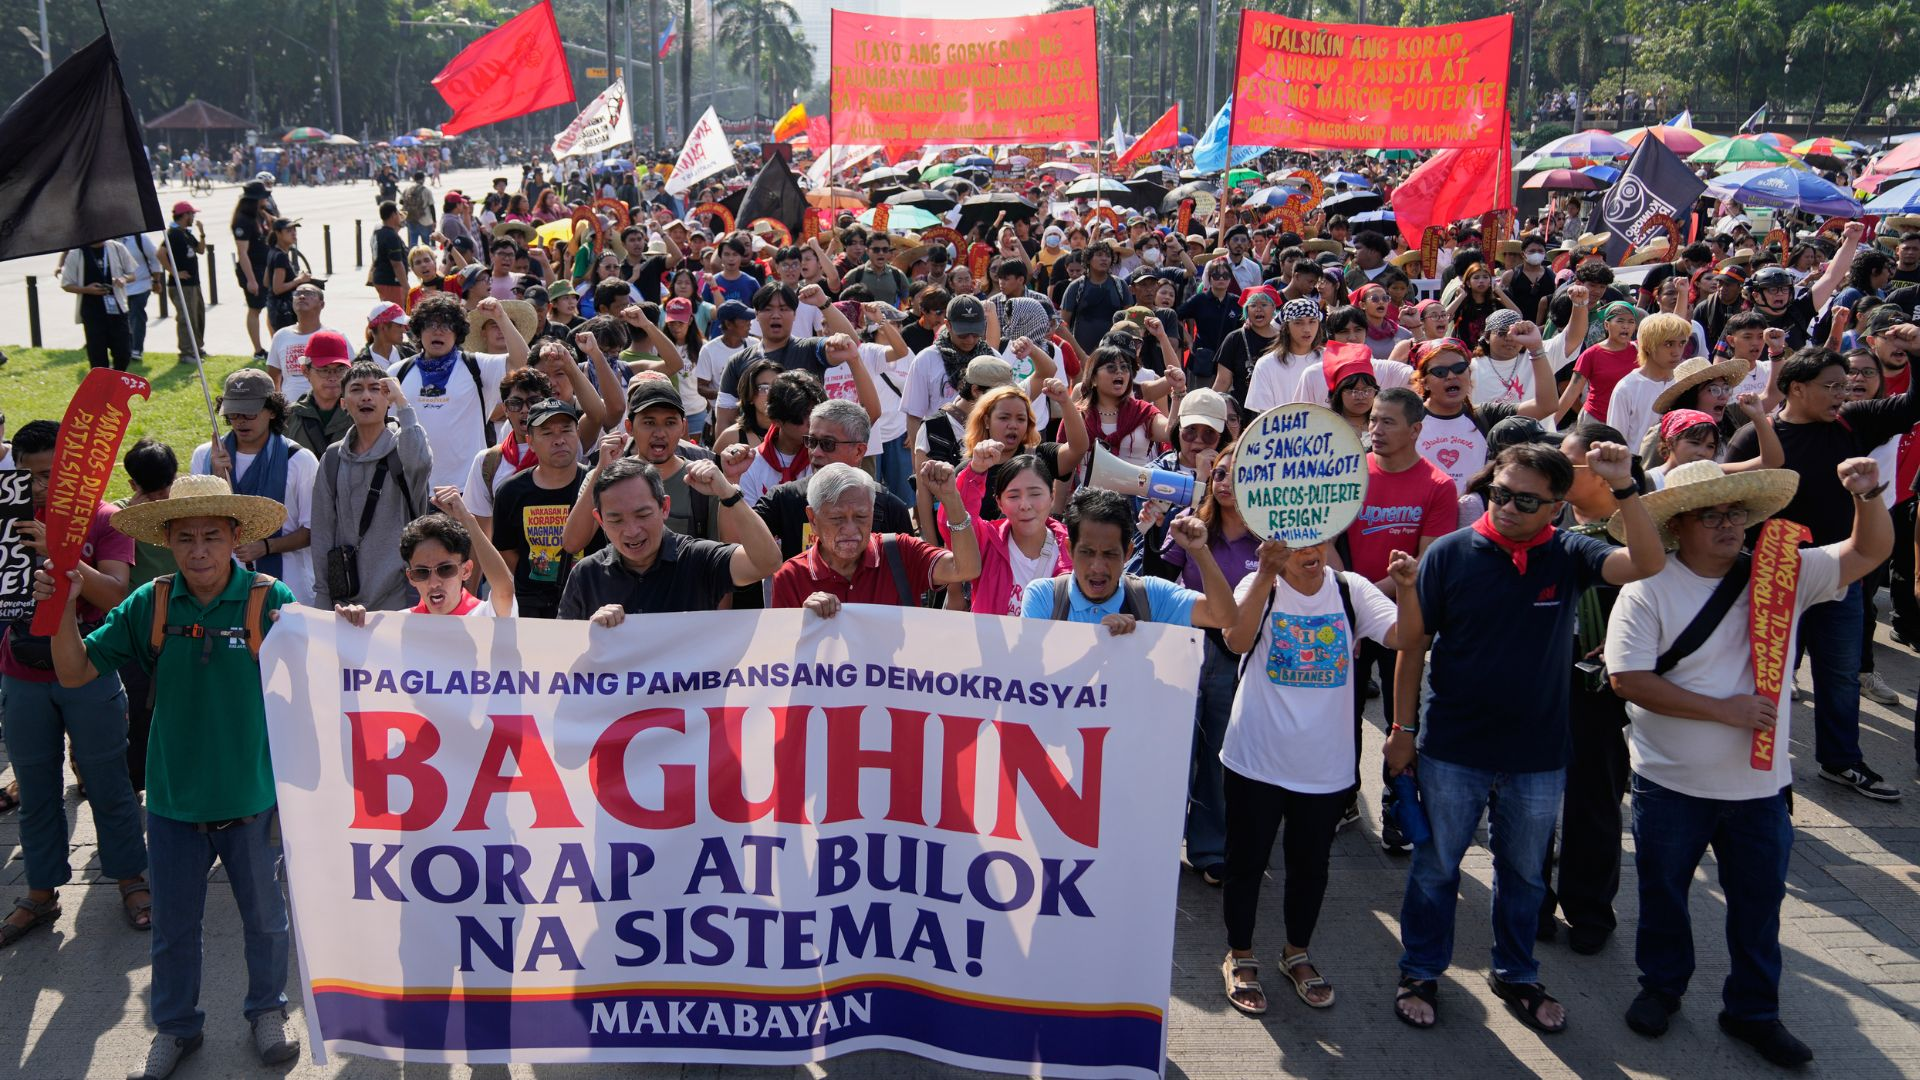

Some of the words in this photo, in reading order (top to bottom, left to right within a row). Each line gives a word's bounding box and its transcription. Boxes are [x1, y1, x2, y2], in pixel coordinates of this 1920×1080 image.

[854, 39, 901, 63] ITAYO
[908, 42, 941, 64] ANG
[946, 38, 1033, 65] GOBYERNO
[1039, 34, 1063, 56] NG
[1251, 20, 1345, 57] PATALSIKIN
[1349, 33, 1390, 60] ANG
[944, 64, 1032, 89] MAKIBAKA
[1038, 58, 1085, 82] PARA
[1352, 59, 1434, 85] PASISTA
[1440, 56, 1472, 83] AT
[831, 91, 851, 113] SA
[859, 91, 970, 113] PAMBANSANG
[1238, 76, 1311, 107] PESTENG
[1316, 80, 1504, 112] MARCOS-DUTERTE!
[992, 120, 1009, 136] NG
[1307, 119, 1388, 142] MAGBUBUKID
[1390, 125, 1409, 142] NG
[1412, 123, 1479, 143] PILIPINAS
[1262, 411, 1310, 436] LAHAT
[1246, 441, 1260, 456] NG
[1264, 432, 1335, 460] SANGKOT,
[50, 408, 95, 517] PATALSIKIN!
[1238, 462, 1277, 484] DAPAT
[1282, 454, 1361, 480] MANAGOT!
[1247, 482, 1362, 508] MARCOS-DUTERTE
[530, 508, 561, 516] WAKASAN
[1268, 506, 1331, 531] RESIGN!
[1358, 504, 1423, 526] upreme
[1775, 520, 1802, 592] BAYAN!
[1777, 591, 1786, 605] NG
[1753, 605, 1769, 638] ANG
[1766, 608, 1790, 693] COUNCIL
[1281, 668, 1333, 682] BATANES
[1757, 642, 1768, 691] ITAYO
[342, 669, 540, 697] IPAGLABAN
[549, 671, 619, 696] ANG
[625, 662, 859, 697] PAMBANSANG
[865, 664, 1109, 710] DEMOKRASYA!
[348, 703, 1112, 849] BAGUHIN
[350, 841, 656, 906] KORAP
[685, 835, 787, 896] AT
[816, 833, 1096, 918] BULOK
[457, 914, 583, 974] NA
[615, 901, 987, 978] SISTEMA!
[589, 991, 874, 1040] MAKABAYAN
